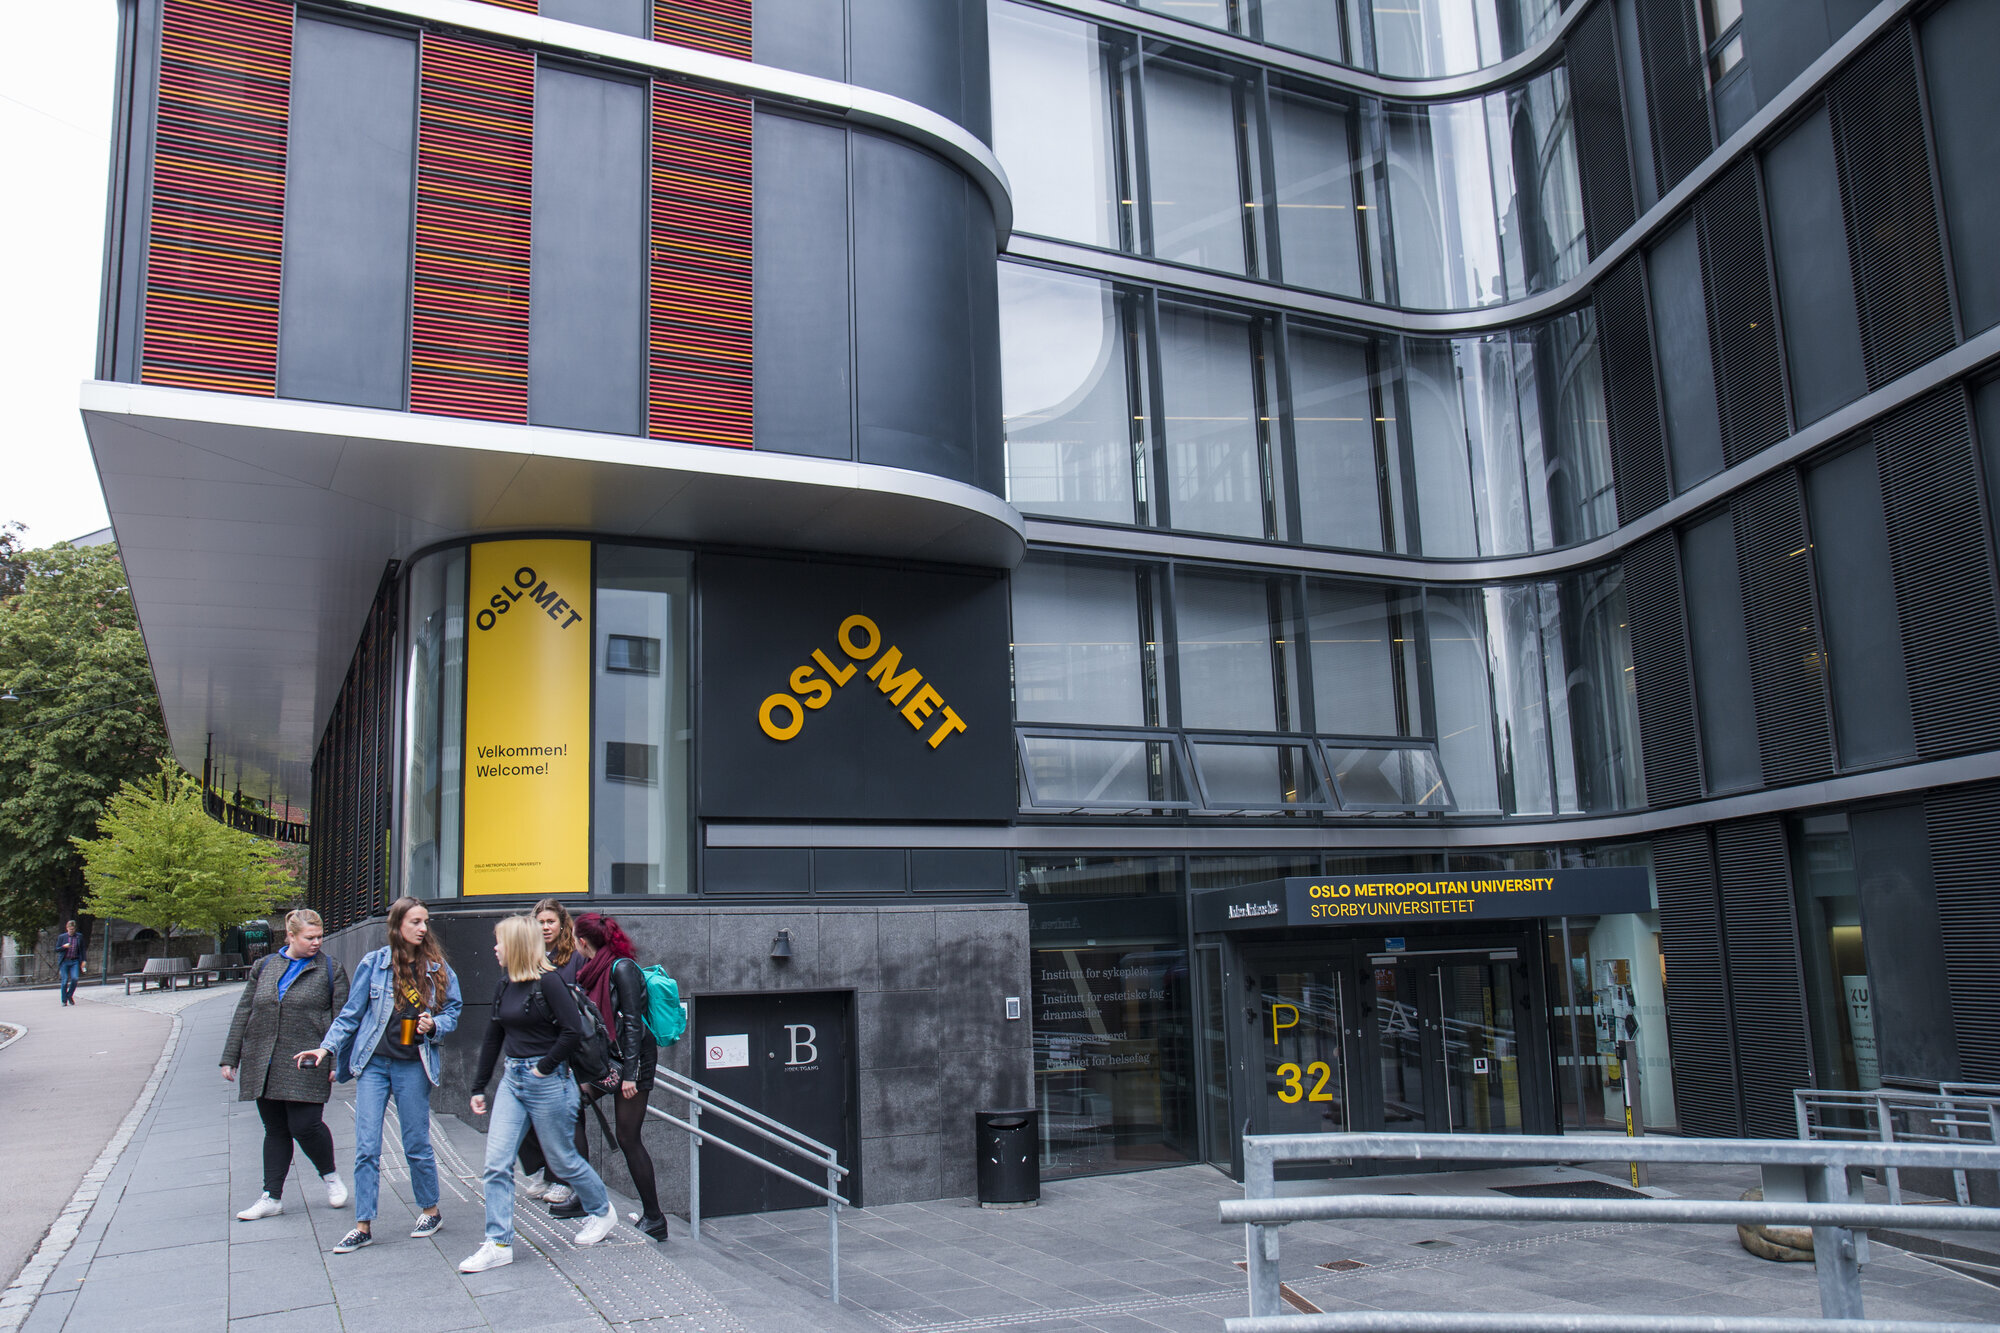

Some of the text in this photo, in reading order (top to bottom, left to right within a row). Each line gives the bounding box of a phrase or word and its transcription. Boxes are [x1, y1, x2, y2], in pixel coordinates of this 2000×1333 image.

[476, 567, 582, 630] OSLOMET
[758, 614, 968, 749] OSLOMET
[477, 744, 567, 758] Velkommen!
[476, 762, 548, 777] Welcome!
[1309, 878, 1554, 898] OSLO METROPOLITAN UNIVERSITY
[1311, 900, 1475, 918] STORBYUNIVERSITETET
[1042, 965, 1149, 980] Institutt for sykepleie
[1043, 992, 1084, 1004] Institutt
[1087, 991, 1102, 1001] for
[1104, 988, 1148, 1001] estetiske
[1149, 988, 1165, 1001] fag
[1043, 1008, 1102, 1021] dramasaler
[1272, 1003, 1299, 1044] P
[1382, 1001, 1420, 1033] A
[784, 1024, 818, 1065] B
[1092, 1054, 1106, 1066] for
[1108, 1052, 1150, 1065] helsefag
[1276, 1061, 1333, 1104] 32
